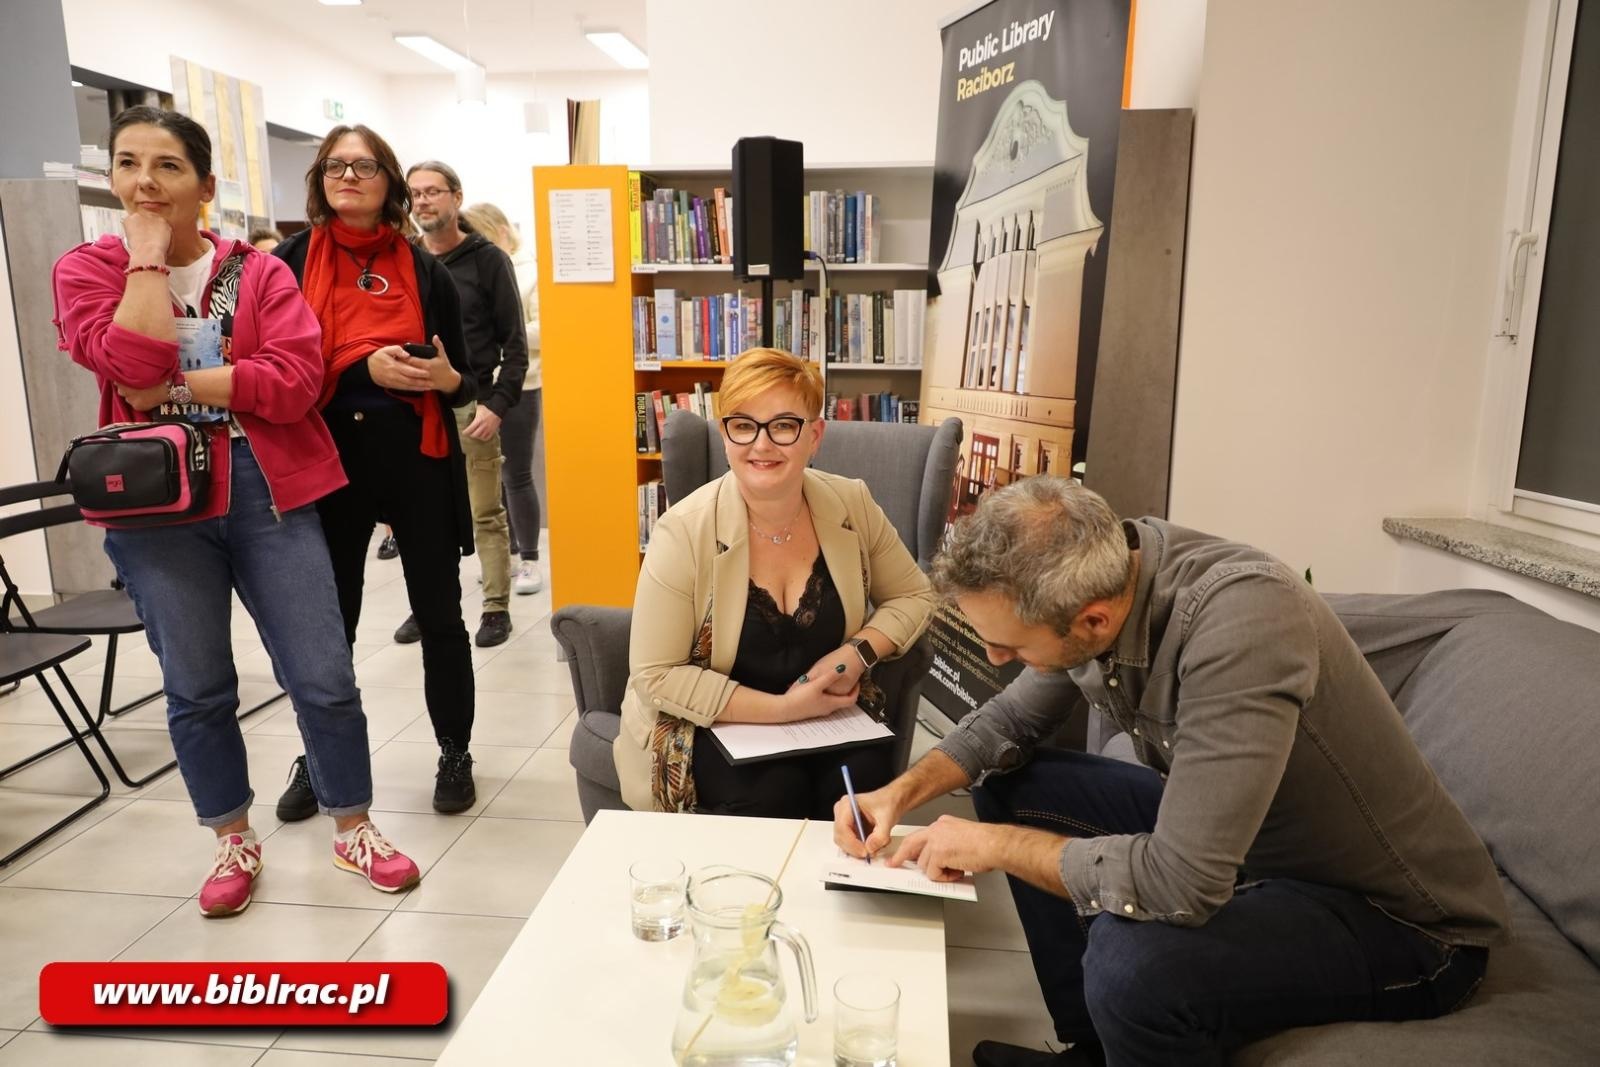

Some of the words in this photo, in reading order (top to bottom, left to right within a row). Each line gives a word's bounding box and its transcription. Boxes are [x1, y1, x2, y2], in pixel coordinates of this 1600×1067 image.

[959, 33, 999, 72] Public
[1002, 10, 1055, 53] Library
[957, 62, 1015, 102] Raciborz
